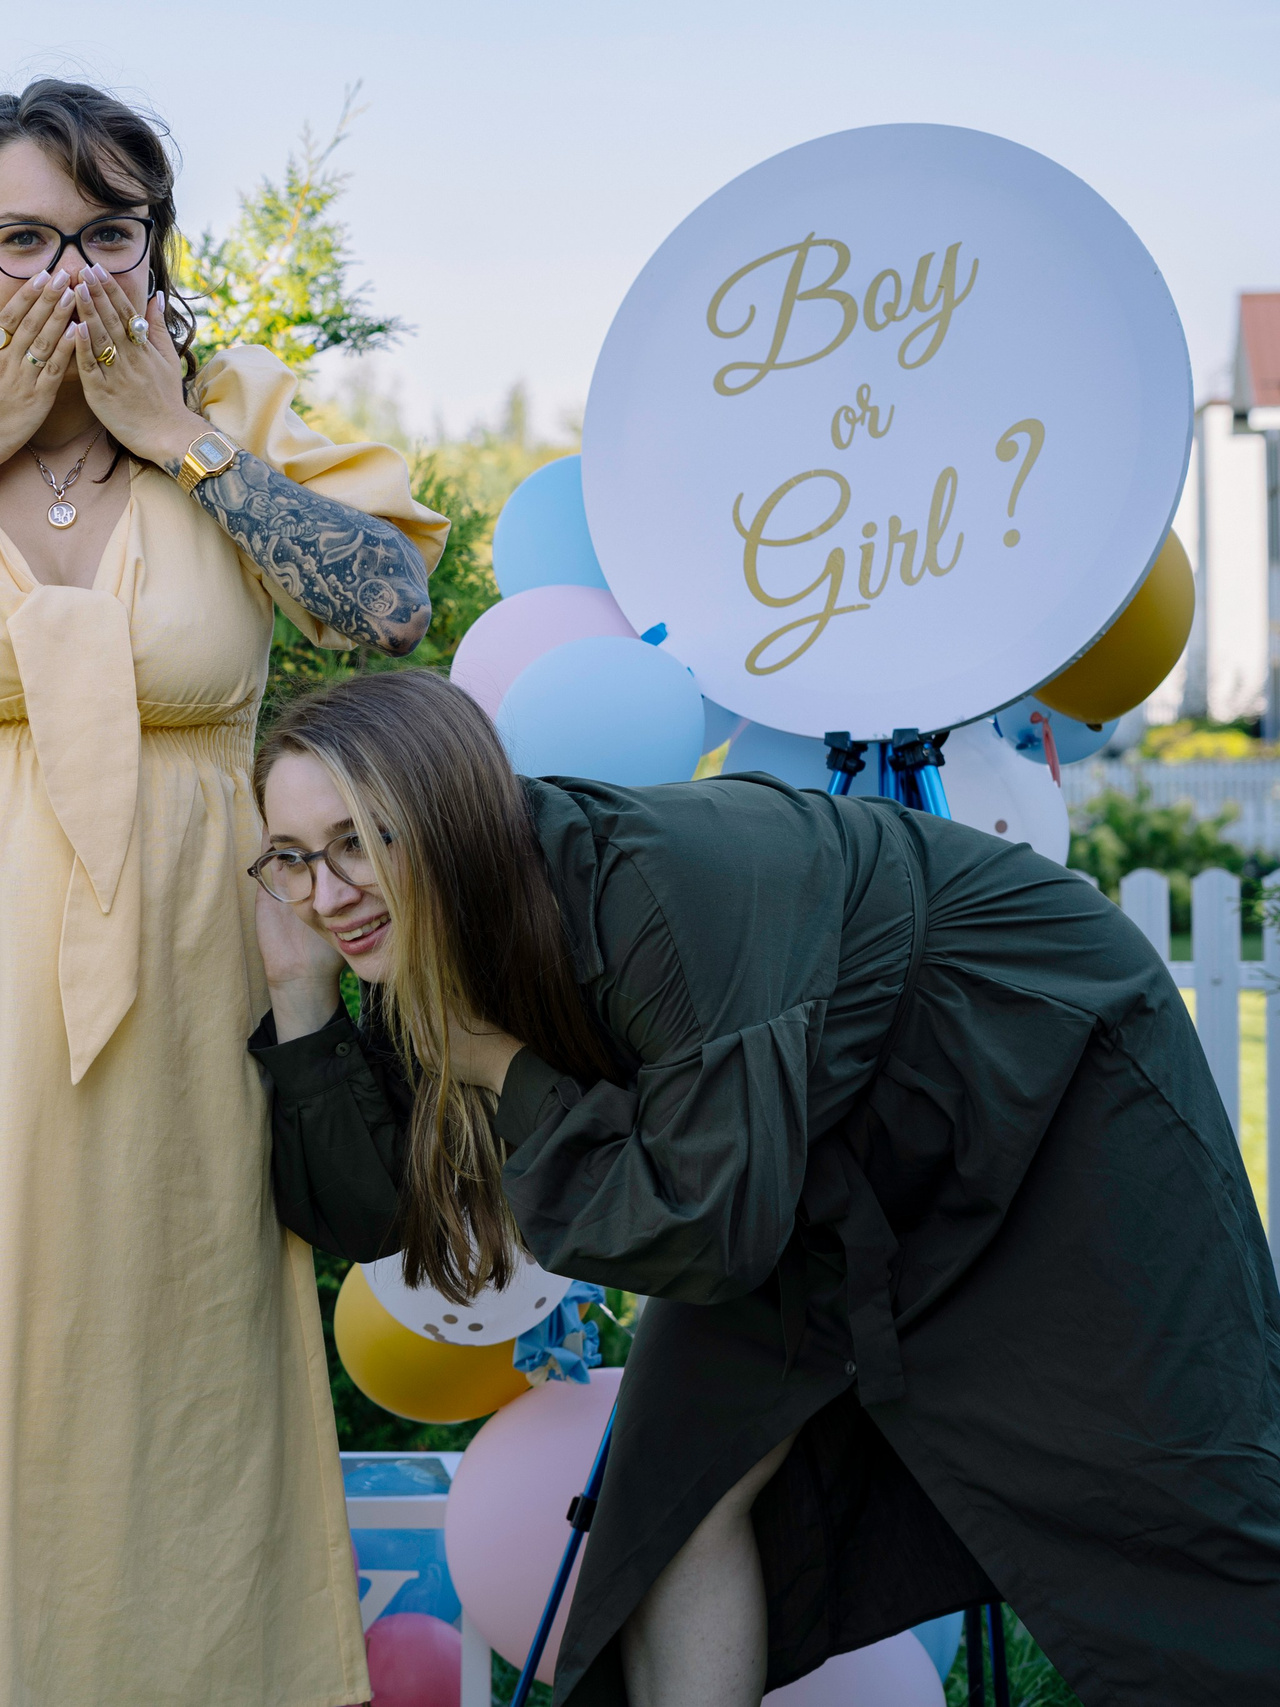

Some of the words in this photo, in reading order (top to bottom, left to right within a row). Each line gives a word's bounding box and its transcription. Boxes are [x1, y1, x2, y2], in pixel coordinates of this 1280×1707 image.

[707, 232, 978, 397] Boy
[832, 384, 894, 449] or
[733, 467, 964, 675] Girl
